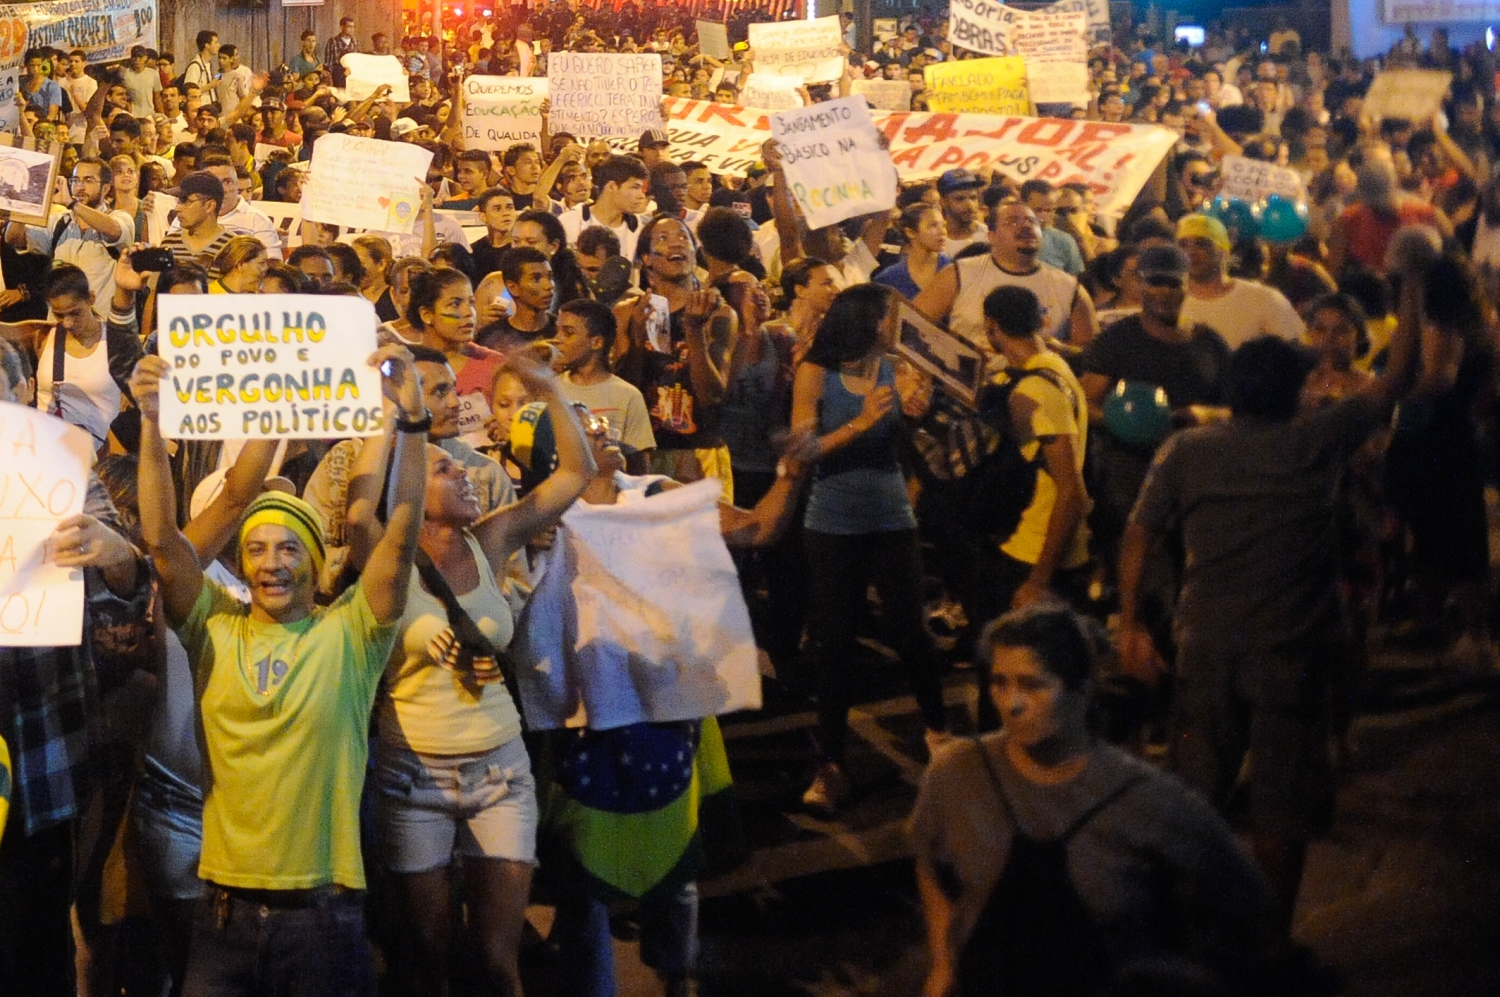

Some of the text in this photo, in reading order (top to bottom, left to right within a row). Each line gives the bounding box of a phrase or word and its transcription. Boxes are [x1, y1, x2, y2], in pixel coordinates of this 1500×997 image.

[553, 56, 569, 73] EU
[467, 80, 534, 95] QUEREMOS
[551, 77, 566, 91] SE
[629, 77, 638, 91] O
[466, 100, 540, 119] EDUCAÇÃO
[778, 107, 850, 135] SANEAMENTO
[465, 125, 480, 139] DE
[839, 137, 856, 154] NA
[793, 180, 874, 214] ROCINHA
[169, 311, 326, 348] ORGULHO
[174, 348, 309, 369] DO POVO E
[173, 367, 360, 404] VERGONHA
[179, 403, 384, 434] AOS POLÍTICOS
